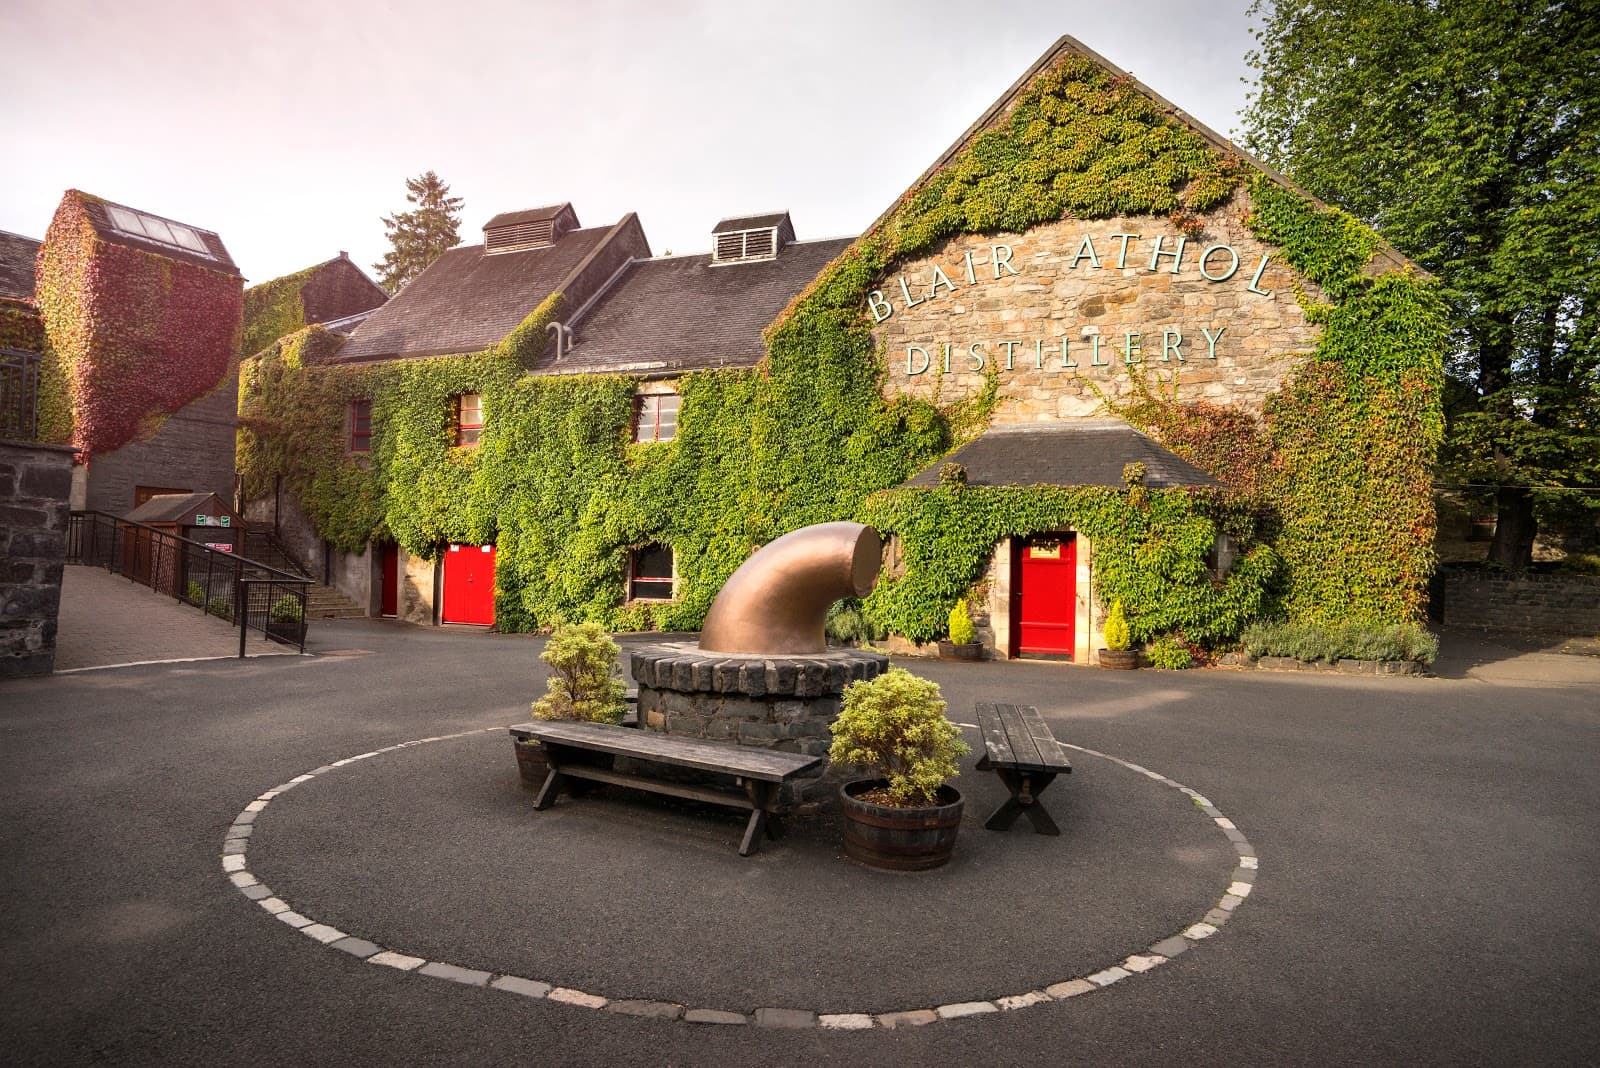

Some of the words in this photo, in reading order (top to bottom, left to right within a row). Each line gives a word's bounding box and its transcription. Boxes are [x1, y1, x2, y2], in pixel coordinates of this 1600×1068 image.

[868, 245, 1020, 323] BLAIR
[1069, 233, 1270, 296] ATHOL
[906, 327, 1226, 376] DISTILLERY
